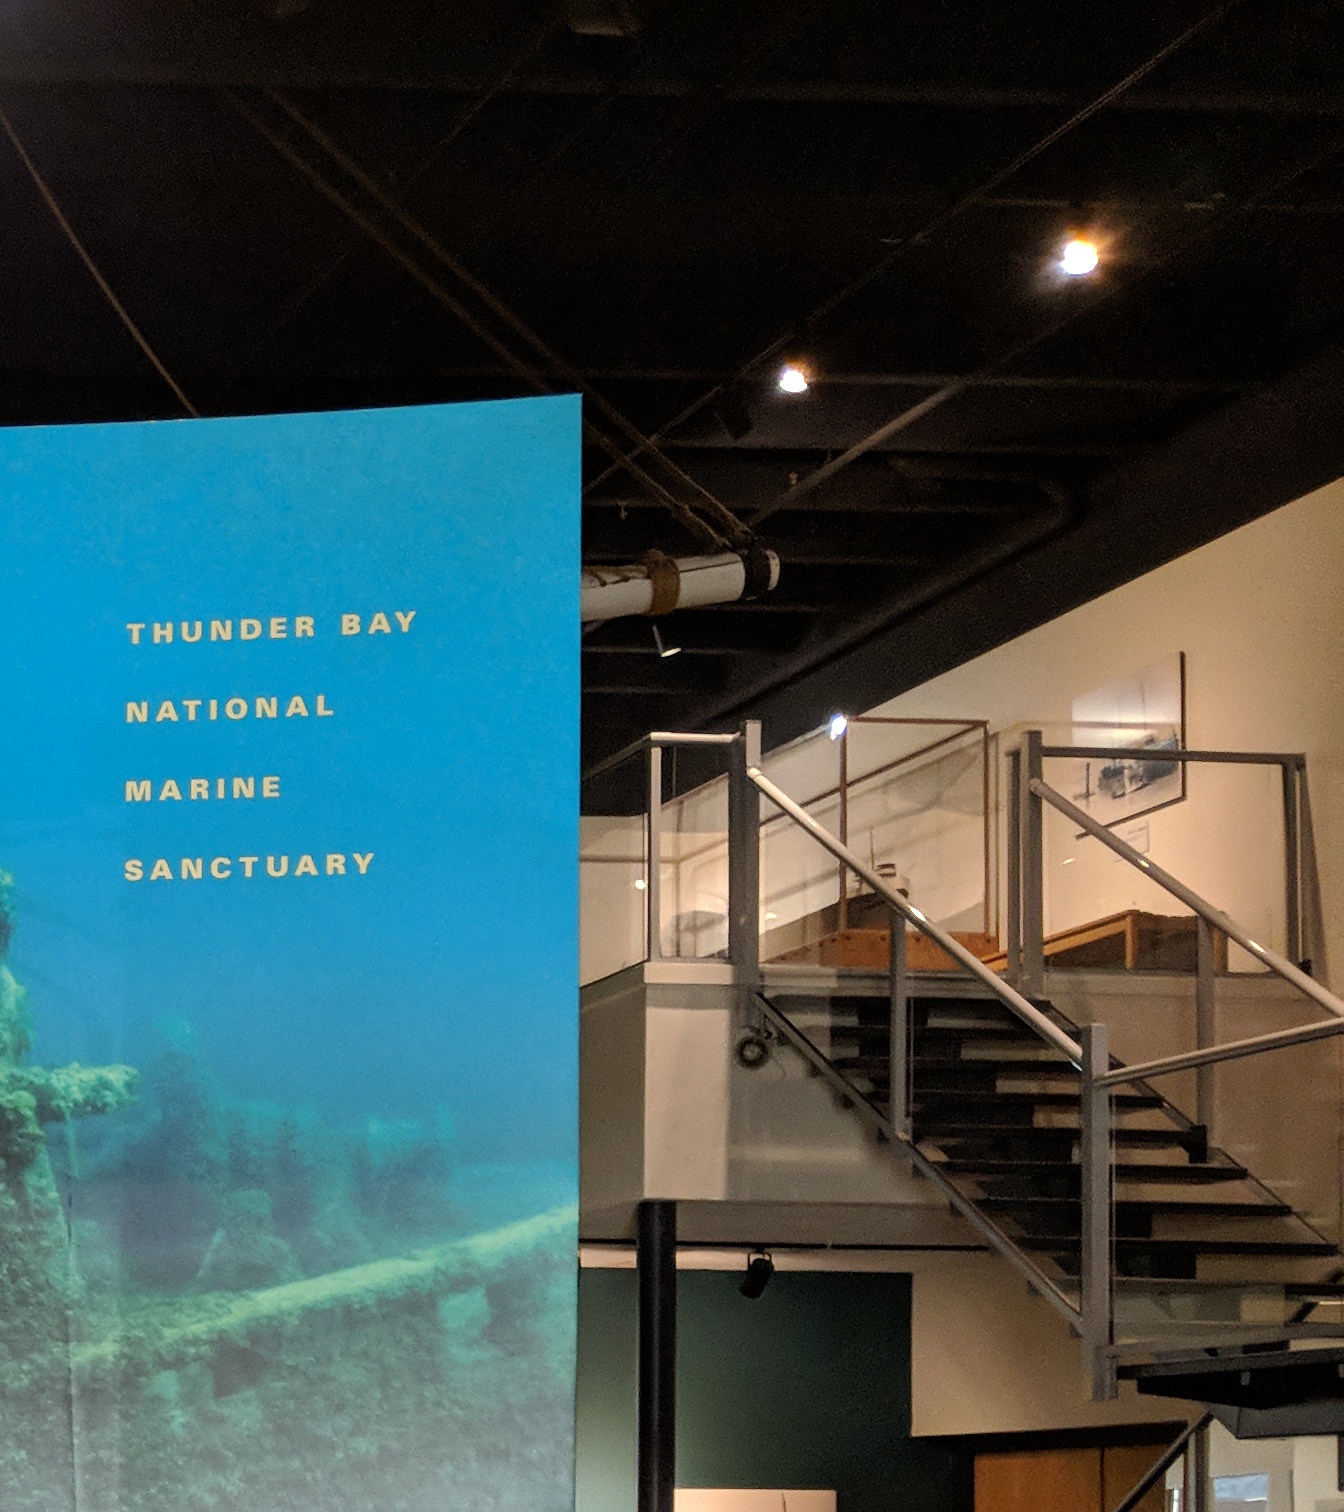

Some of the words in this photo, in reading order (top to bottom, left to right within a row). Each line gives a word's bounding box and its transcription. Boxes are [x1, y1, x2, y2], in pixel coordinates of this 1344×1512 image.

[127, 615, 315, 644] THUNDER
[341, 611, 415, 636] BAY
[126, 694, 333, 723] NATIONAL
[125, 775, 280, 802] MARINE
[124, 853, 374, 882] SANCTUARY
